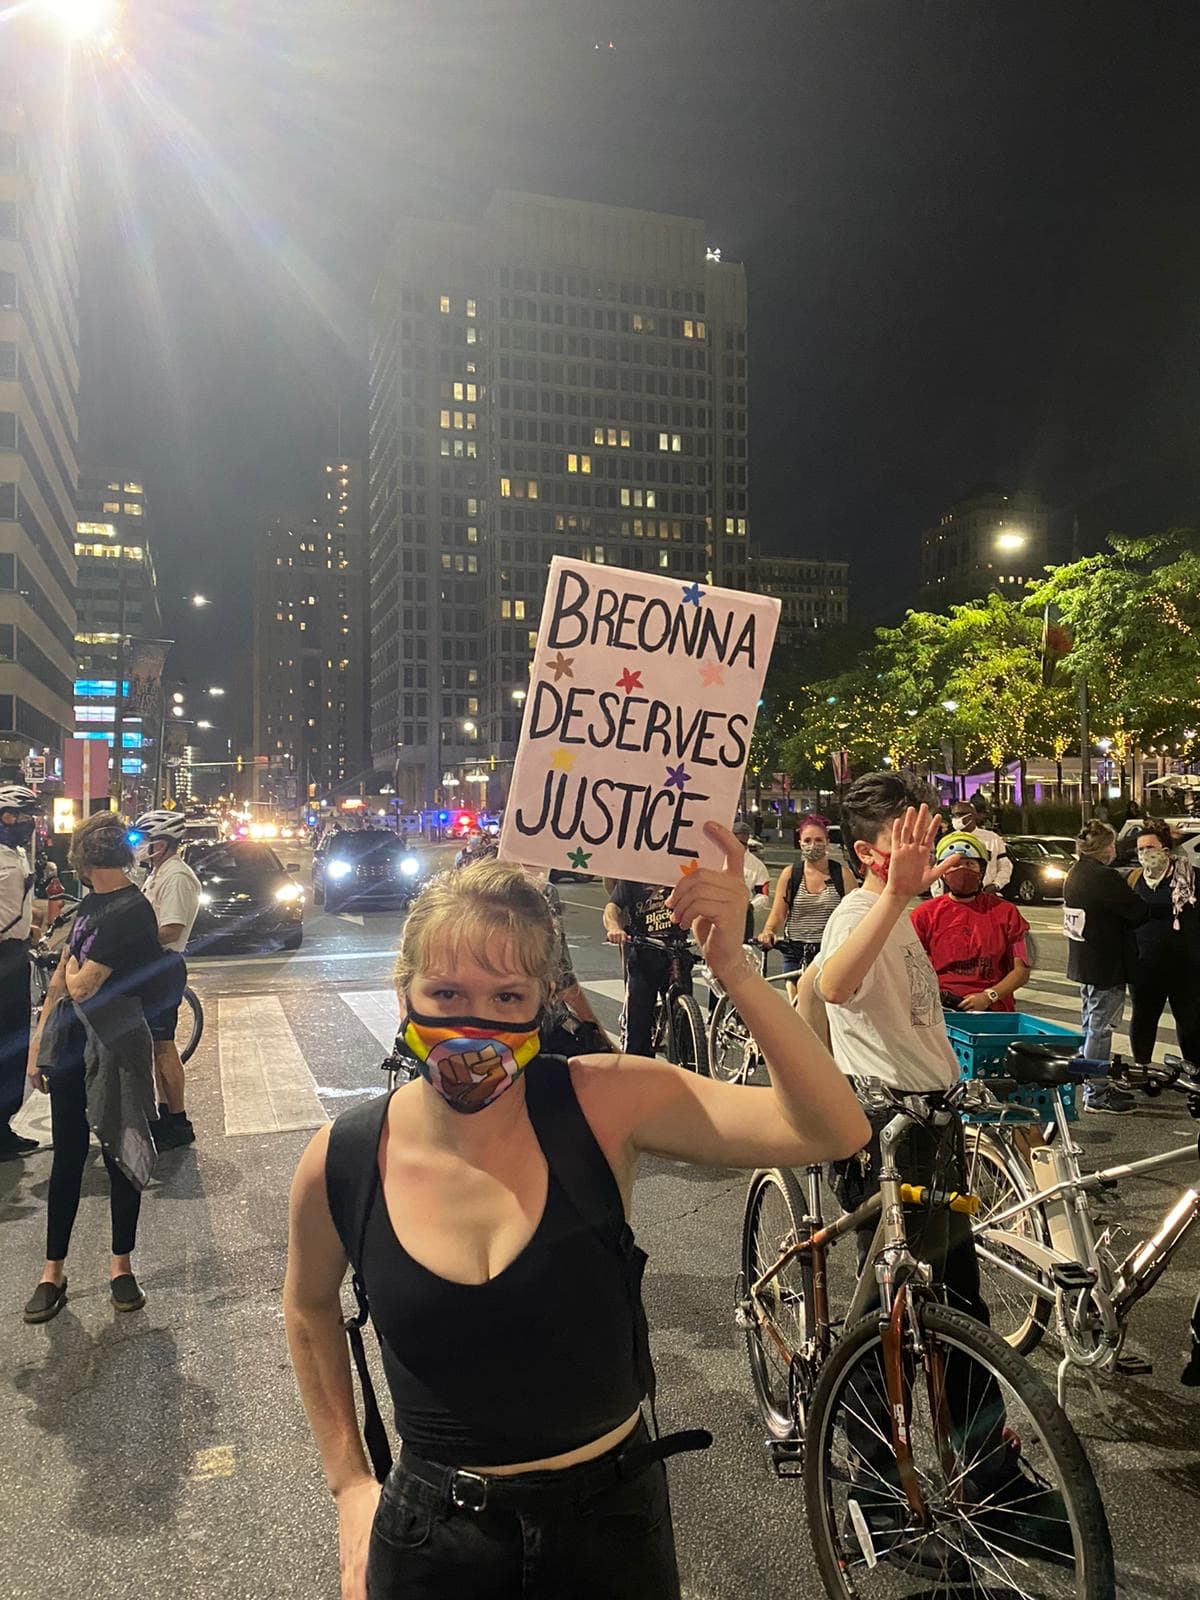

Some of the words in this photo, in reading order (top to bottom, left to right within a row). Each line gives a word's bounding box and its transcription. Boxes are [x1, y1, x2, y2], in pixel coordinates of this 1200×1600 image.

[547, 569, 756, 670] BREONNA
[529, 680, 748, 768] DESERVES
[515, 769, 711, 858] JUSTICE
